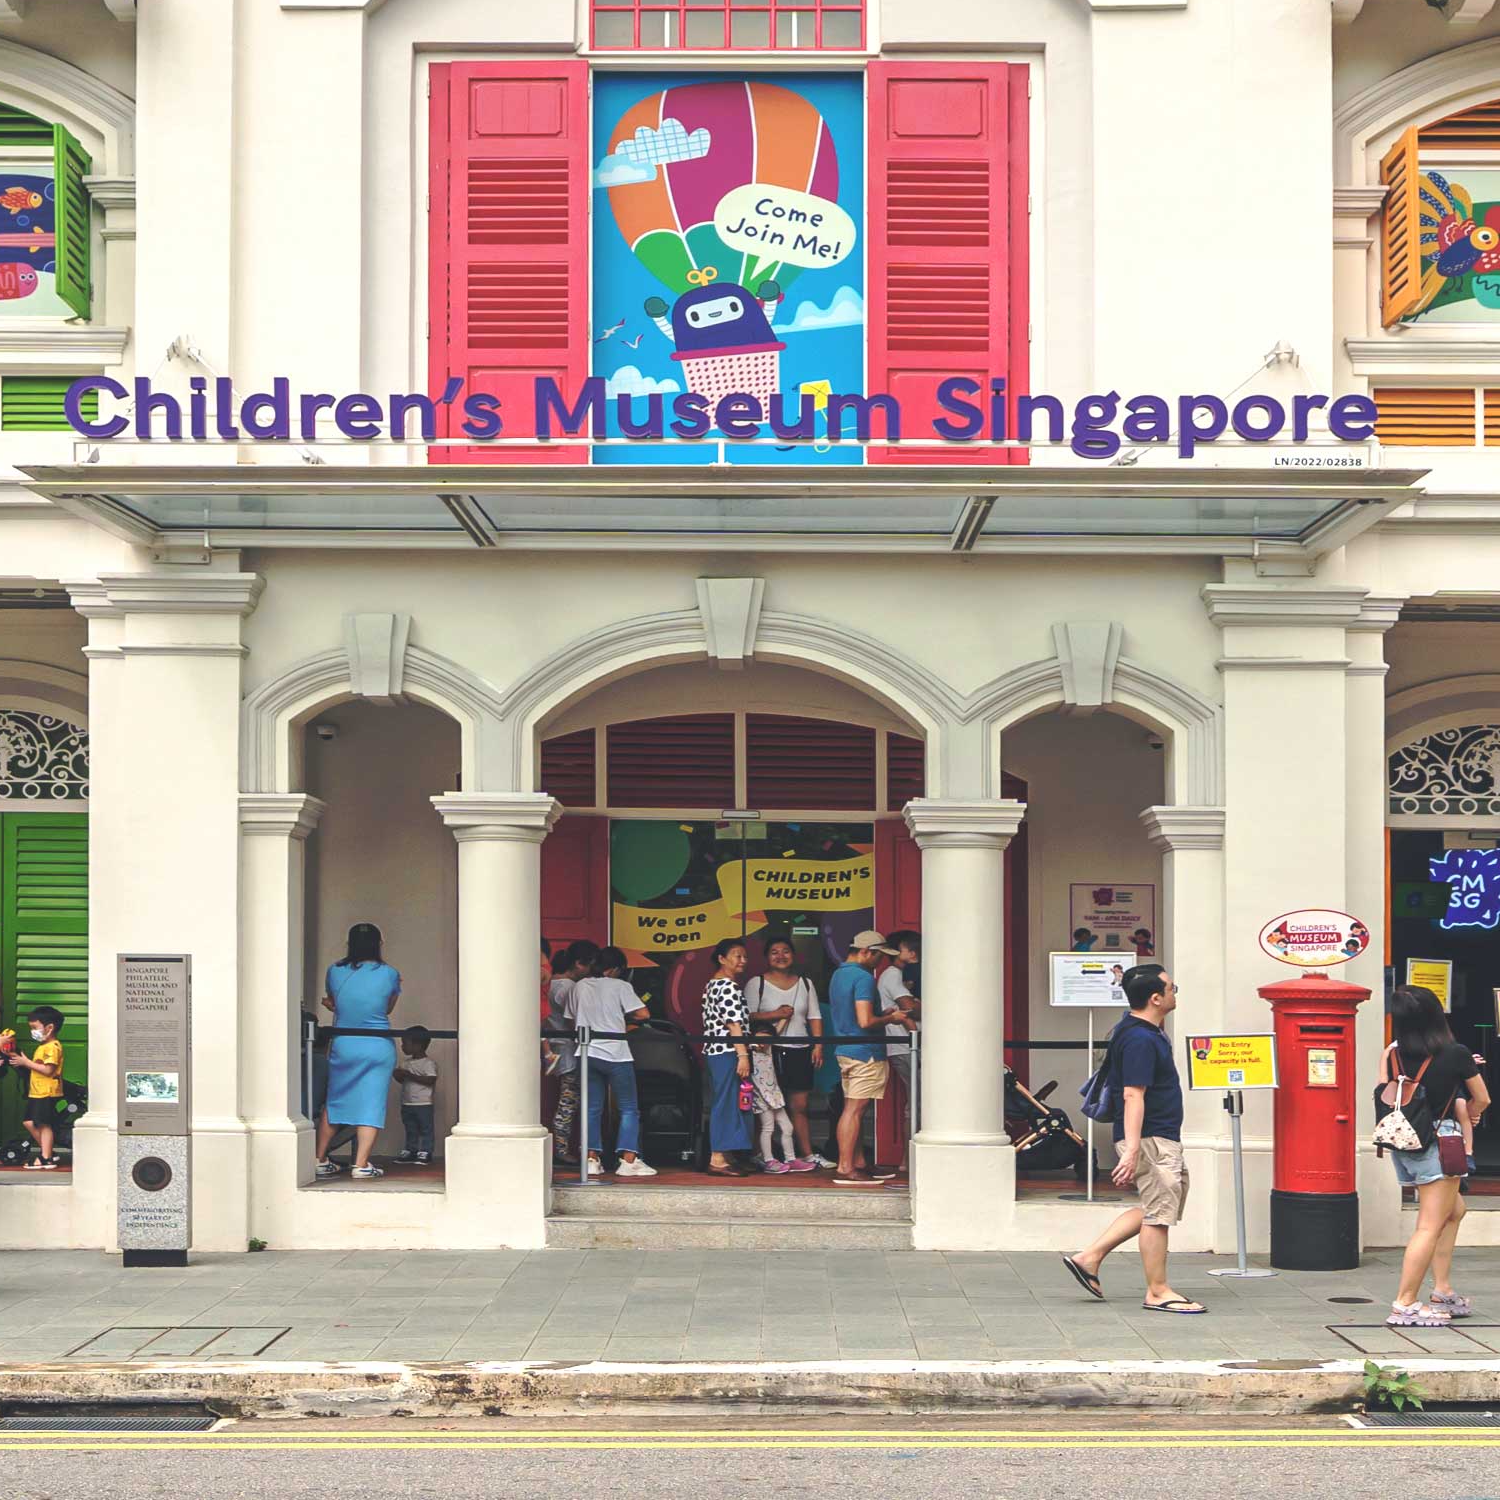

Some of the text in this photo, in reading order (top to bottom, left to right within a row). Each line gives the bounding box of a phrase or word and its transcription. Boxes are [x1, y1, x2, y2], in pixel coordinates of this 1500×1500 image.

[755, 198, 823, 227] Come
[726, 218, 841, 260] Join Me!
[64, 375, 1378, 460] Children's Museum Singapore
[1274, 457, 1362, 467] LN/2022/02838
[753, 866, 871, 884] CHILDREN'S
[765, 886, 851, 900] MUSEUM
[1449, 891, 1481, 908] SG
[637, 912, 707, 928] We are
[1290, 924, 1338, 932] CHILDREN'S
[652, 931, 701, 946] Open
[1290, 933, 1338, 942] MUSEUM
